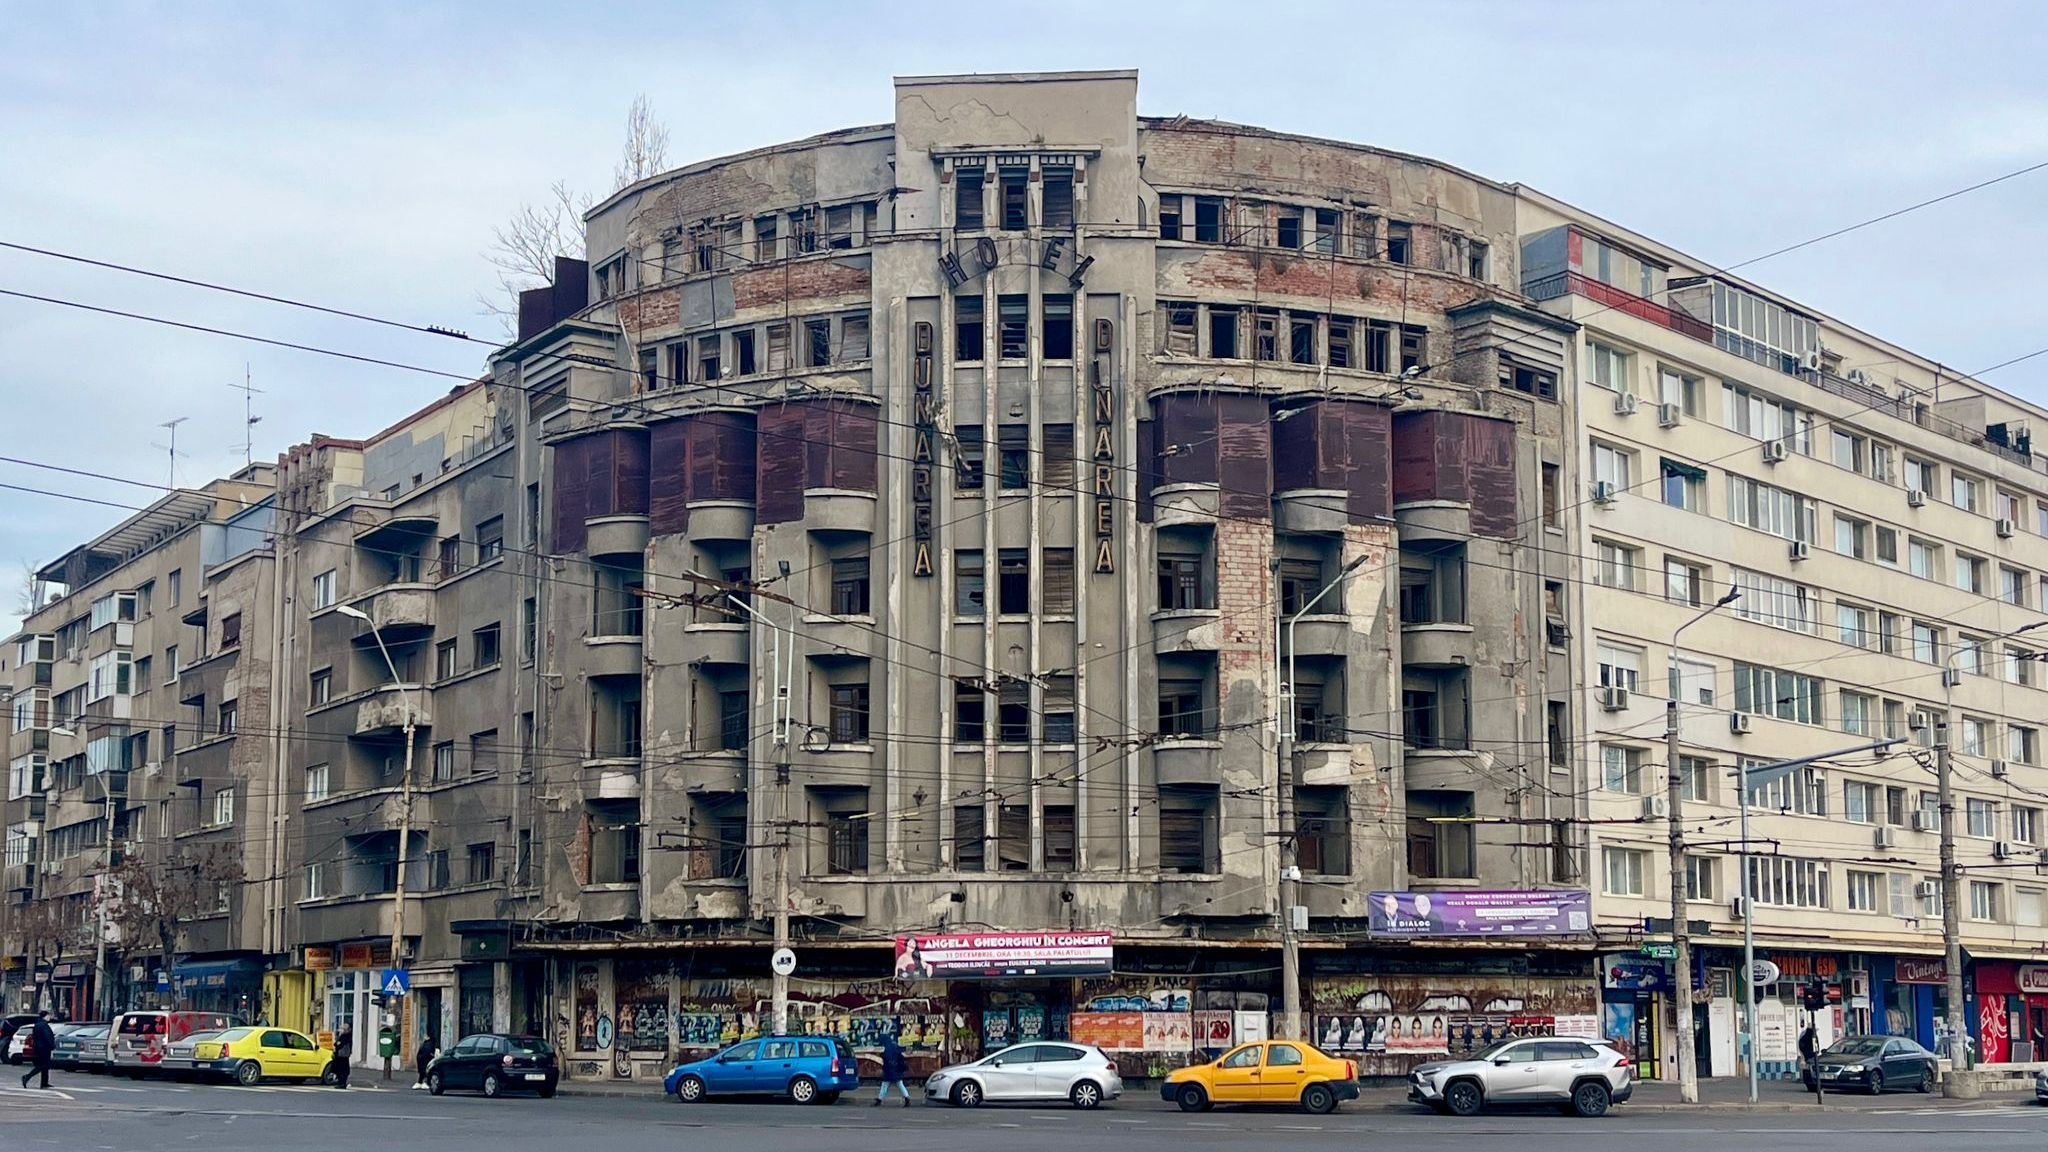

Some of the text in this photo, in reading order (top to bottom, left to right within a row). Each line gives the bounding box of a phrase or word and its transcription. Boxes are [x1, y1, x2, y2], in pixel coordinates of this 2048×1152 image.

[914, 321, 934, 577] DUNAREA
[925, 938, 970, 949] ANGELA
[973, 936, 1042, 947] GHEORGHIU
[1057, 935, 1110, 946] CONCERT
